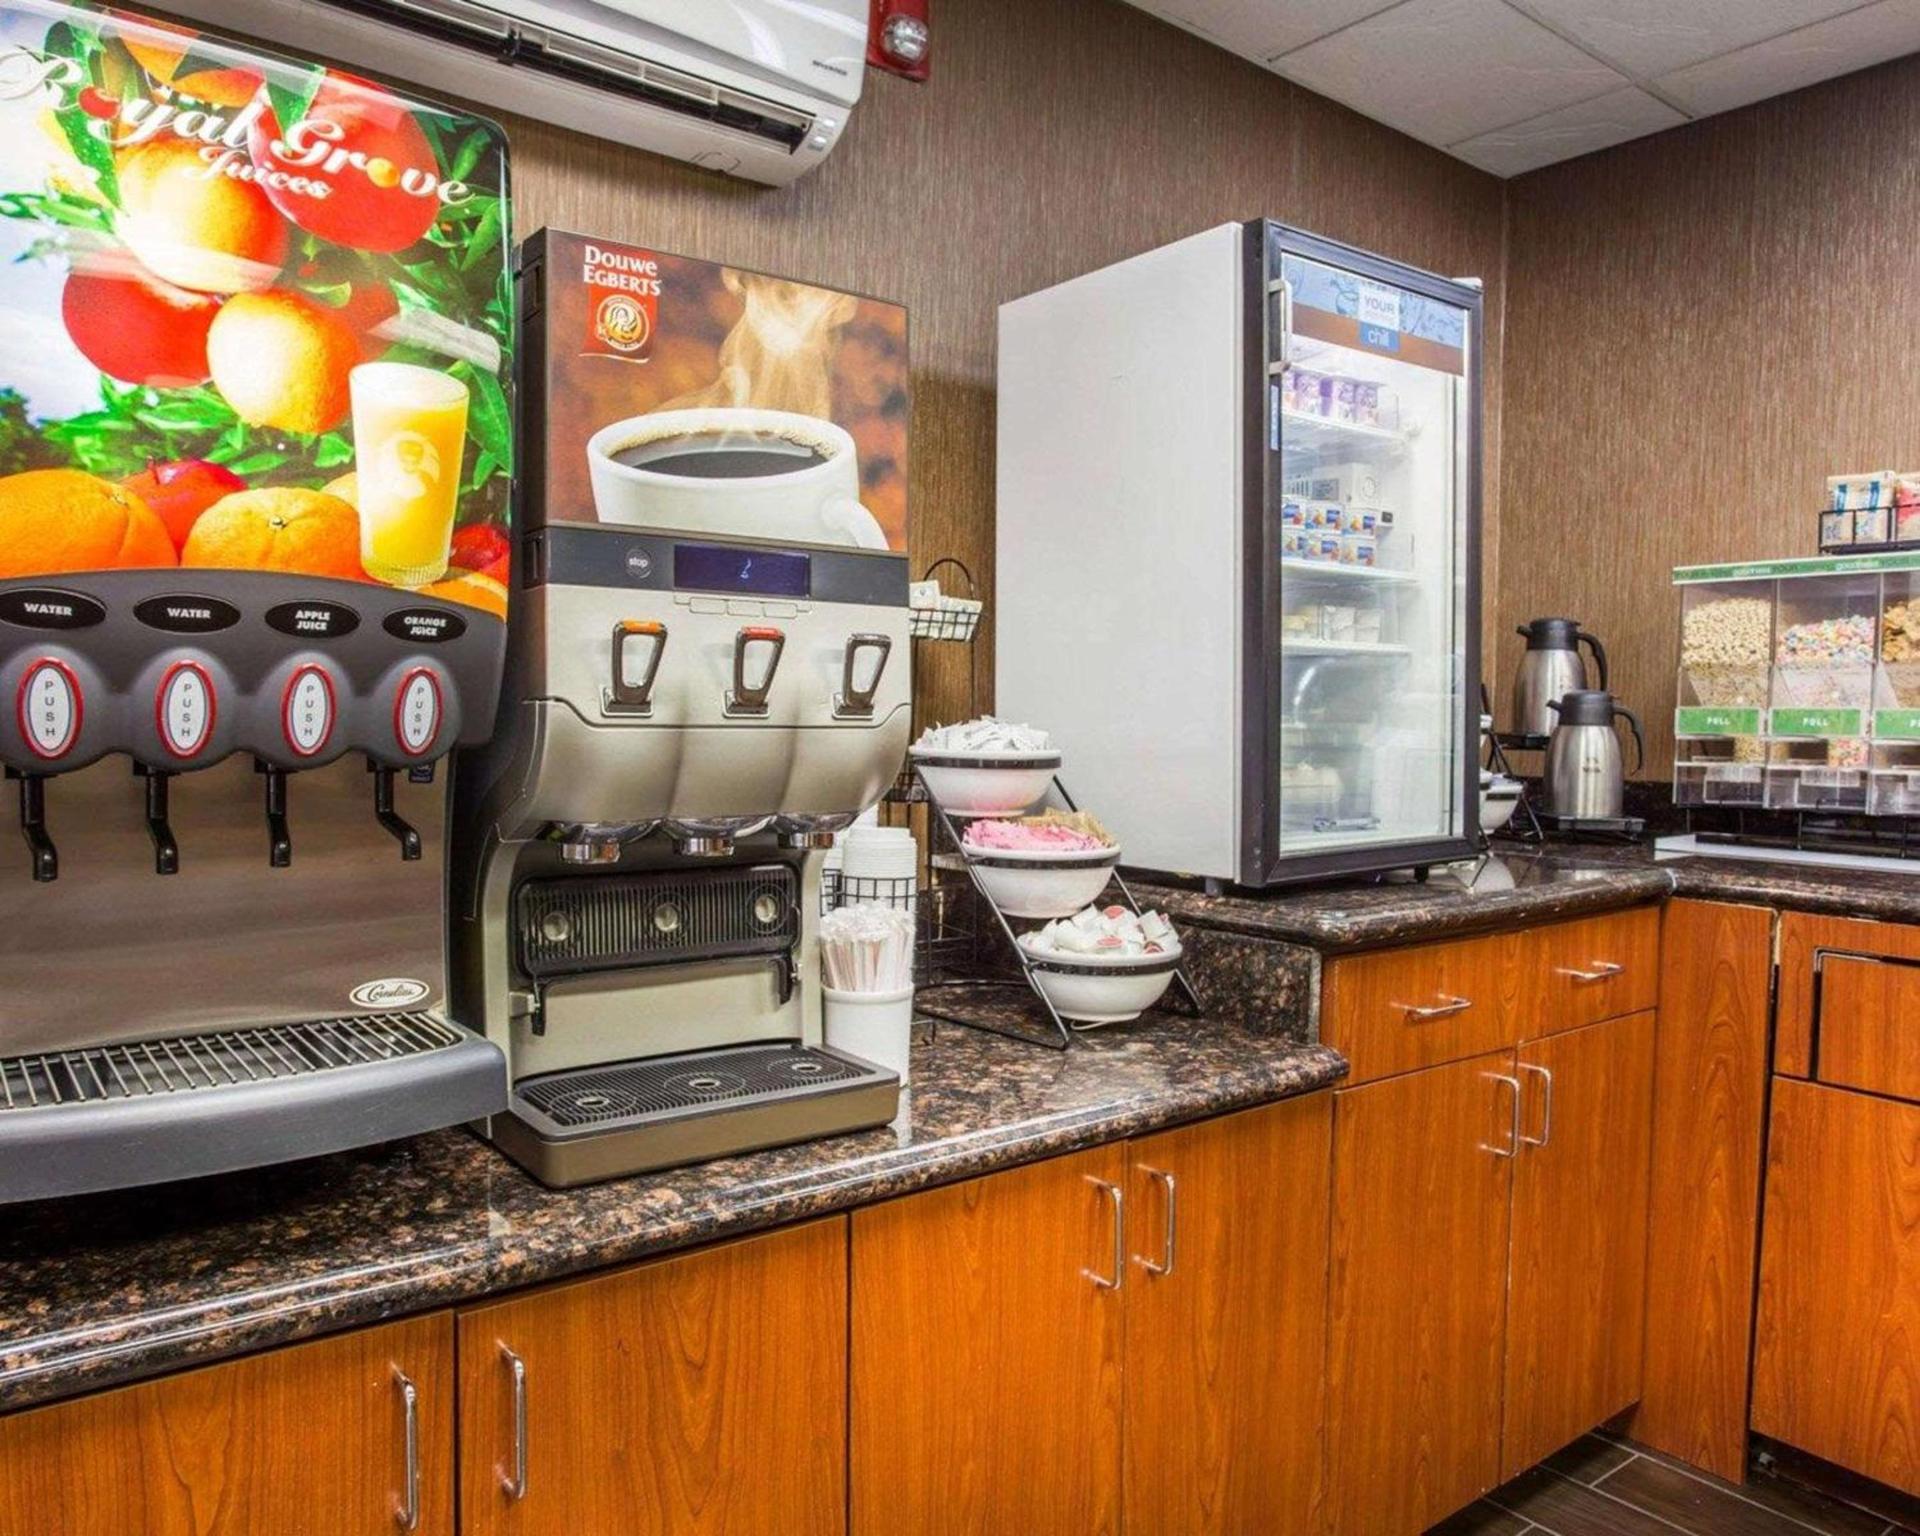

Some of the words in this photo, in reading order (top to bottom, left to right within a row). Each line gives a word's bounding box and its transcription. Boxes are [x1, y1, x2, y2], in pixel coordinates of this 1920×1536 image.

[0, 50, 264, 148] Royal
[270, 118, 476, 204] Grove
[184, 146, 333, 199] Juices
[1365, 295, 1395, 313] YOUR
[629, 557, 648, 569] stop
[24, 602, 73, 616] WATER
[166, 607, 211, 619] WATER
[295, 610, 331, 621] APPLE
[297, 620, 327, 631] JUICE
[404, 616, 447, 627] ORANGE
[410, 626, 438, 637] JUICE
[45, 680, 56, 737] PUSH
[181, 683, 192, 737] PUSH
[304, 685, 315, 736] PUSH
[413, 687, 425, 736] PUSH
